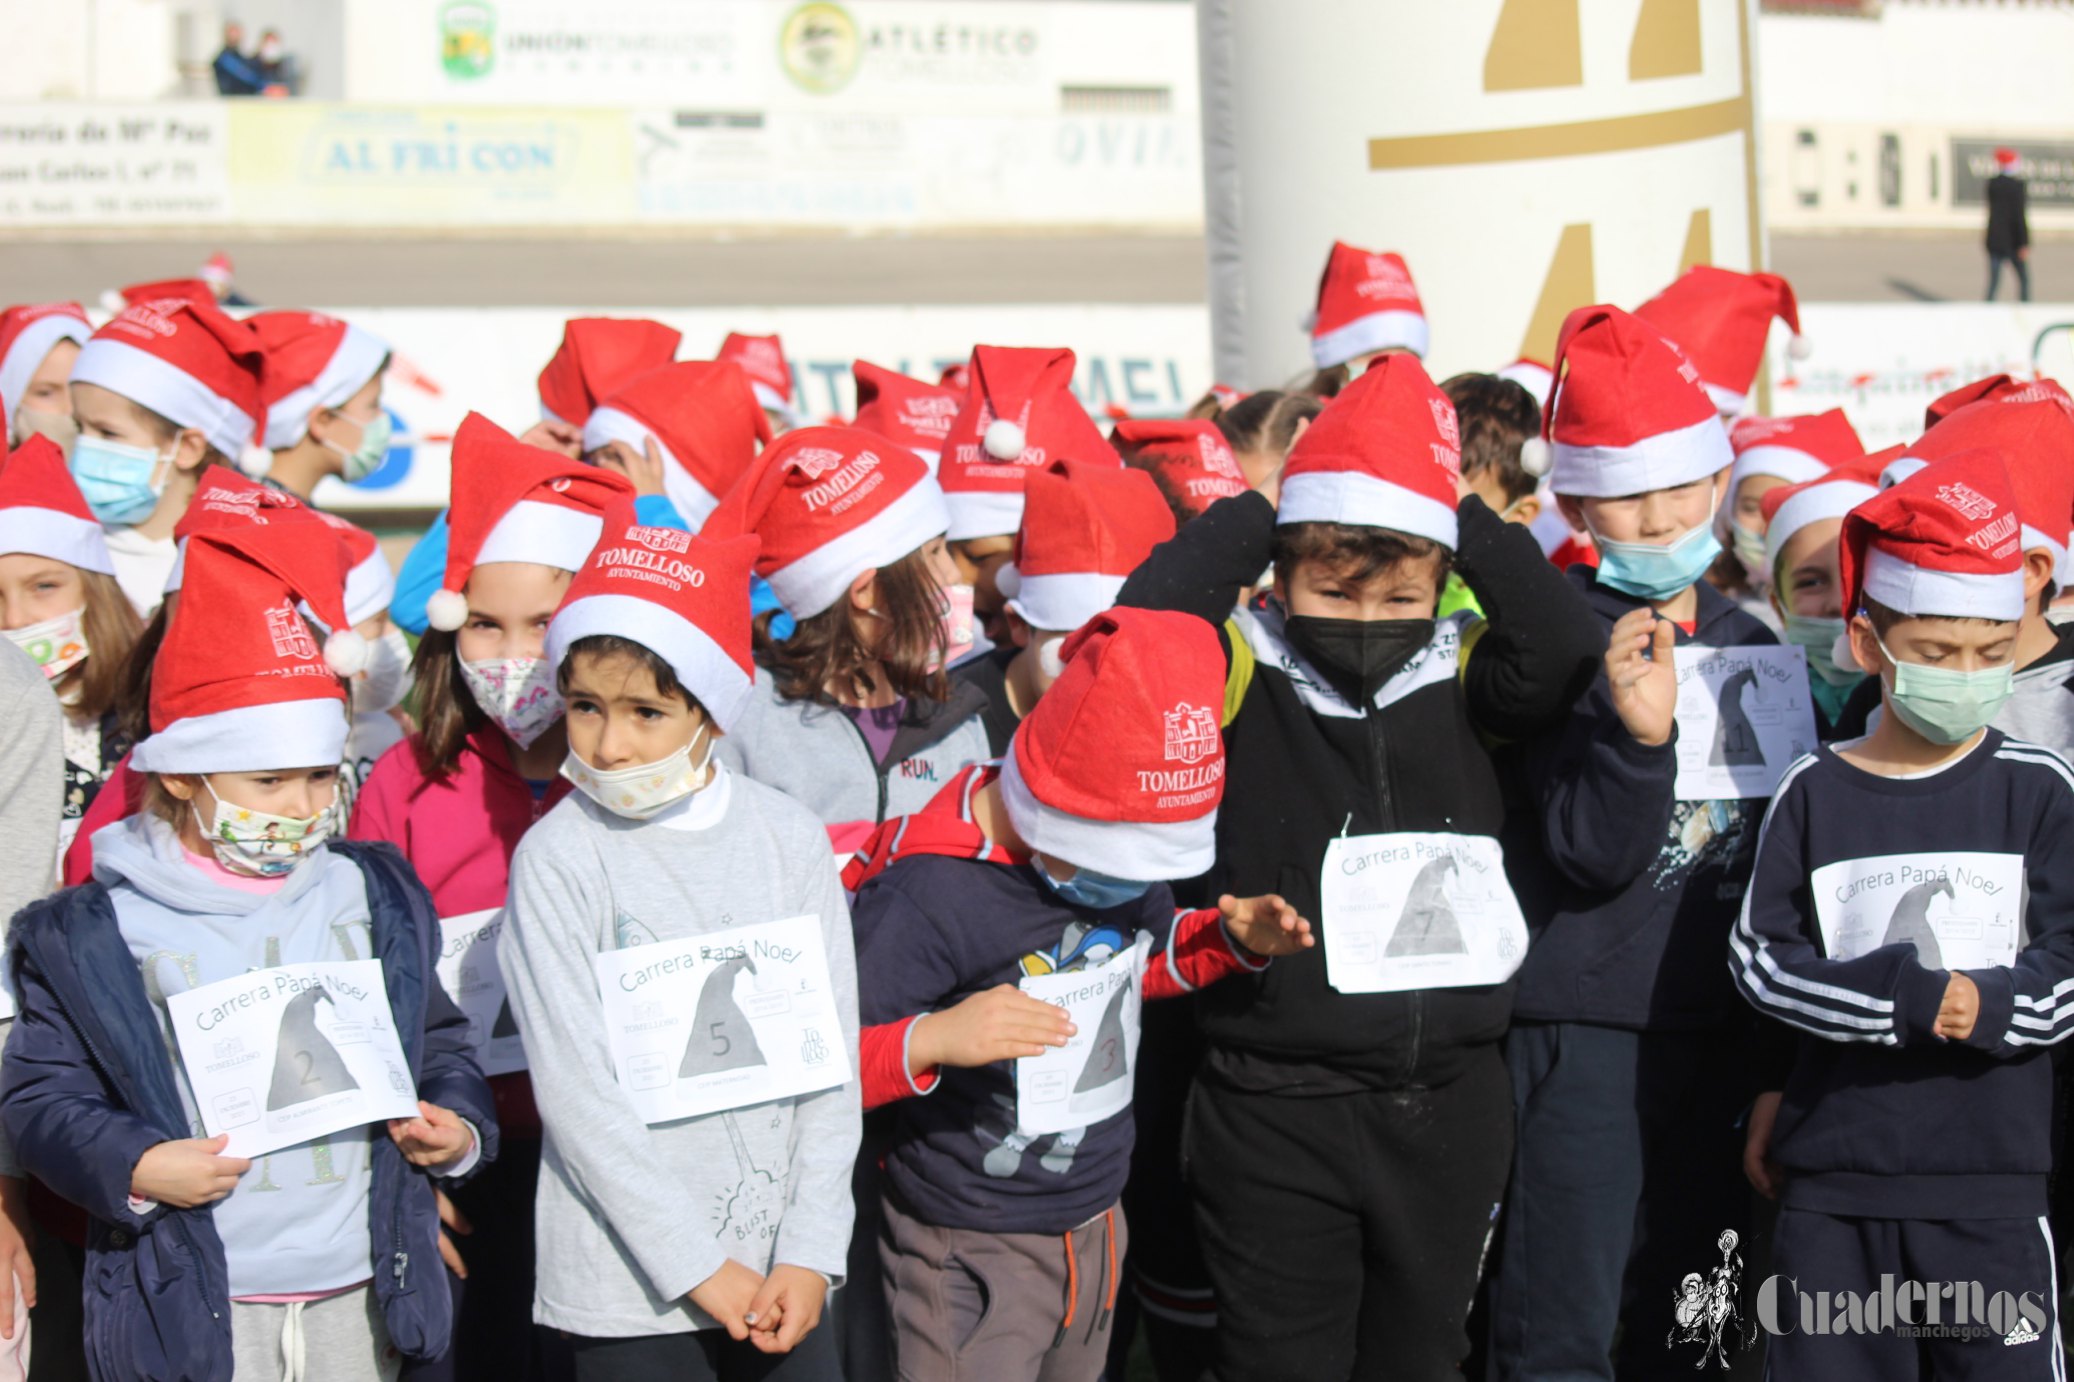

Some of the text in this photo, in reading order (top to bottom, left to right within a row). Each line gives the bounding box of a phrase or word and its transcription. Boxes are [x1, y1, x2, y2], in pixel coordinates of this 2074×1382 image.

[800, 450, 881, 512] TOMELLOSO
[596, 547, 705, 588] TOMELLOSO
[607, 567, 682, 592] AYUNTAMIENTO
[1757, 658, 1793, 684] Noel
[1136, 756, 1225, 793] TOMELLOSO
[1156, 786, 1217, 809] AYUNTAMIENTO
[1341, 841, 1489, 876] Carrera Papá Noel
[1836, 864, 2004, 904] Carrera Papá Noel
[1416, 910, 1435, 942] 7
[619, 938, 803, 992] Carrera Papá Noel
[196, 972, 370, 1032] Carrera Papá Noel
[709, 1021, 731, 1057] 5
[1101, 1038, 1117, 1073] 3
[293, 1050, 322, 1086] 2
[2003, 1332, 2040, 1347] adidas
